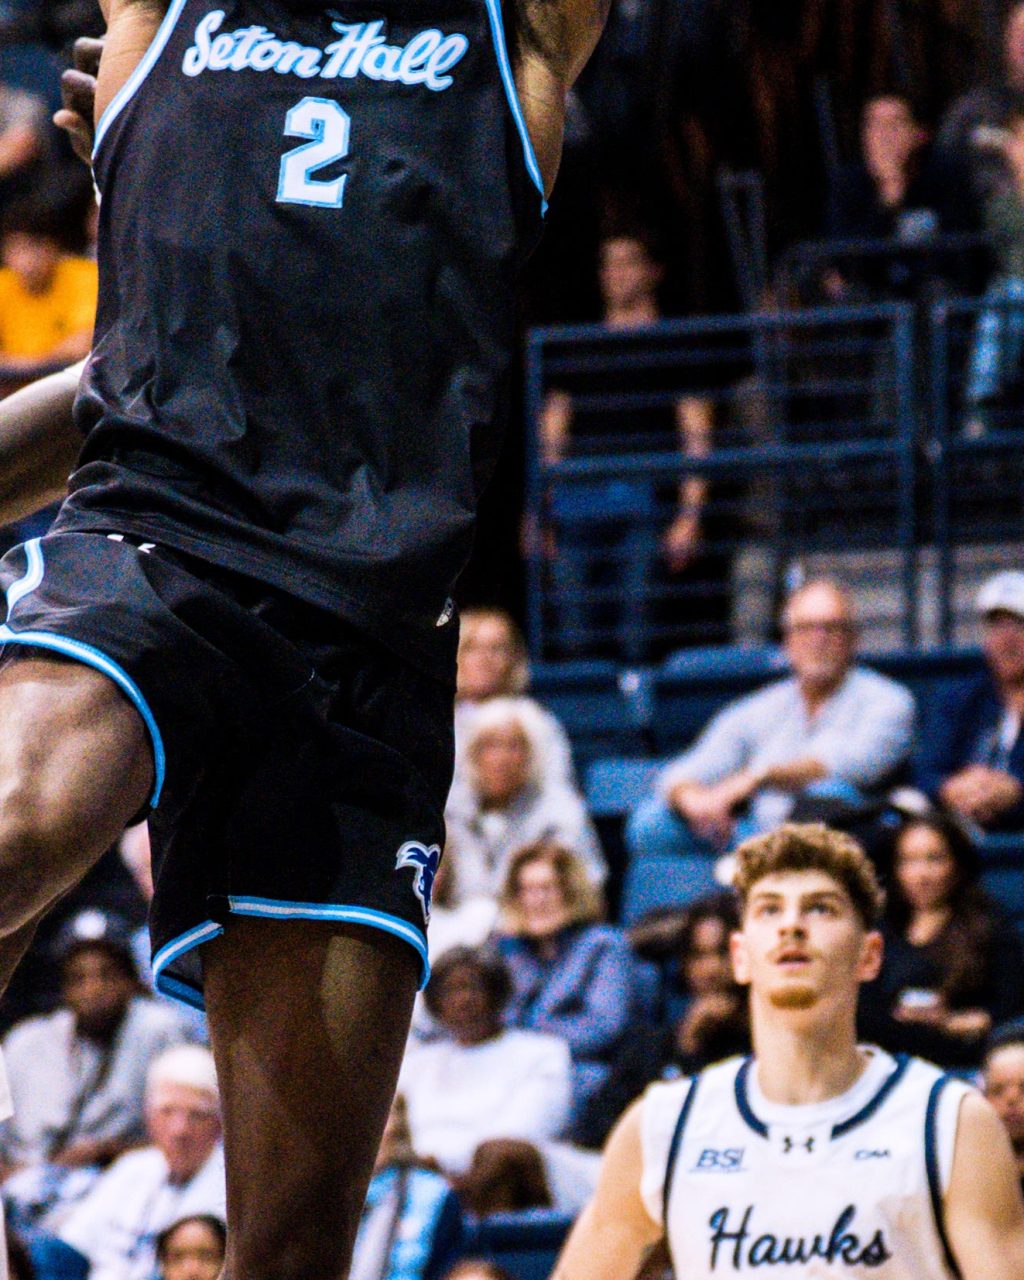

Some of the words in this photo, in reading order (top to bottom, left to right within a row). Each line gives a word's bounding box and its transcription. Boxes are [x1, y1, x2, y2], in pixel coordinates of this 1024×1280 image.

[182, 10, 322, 78] Seton
[319, 20, 470, 92] Hall
[276, 96, 351, 209] 2
[708, 1204, 893, 1272] Hawks
